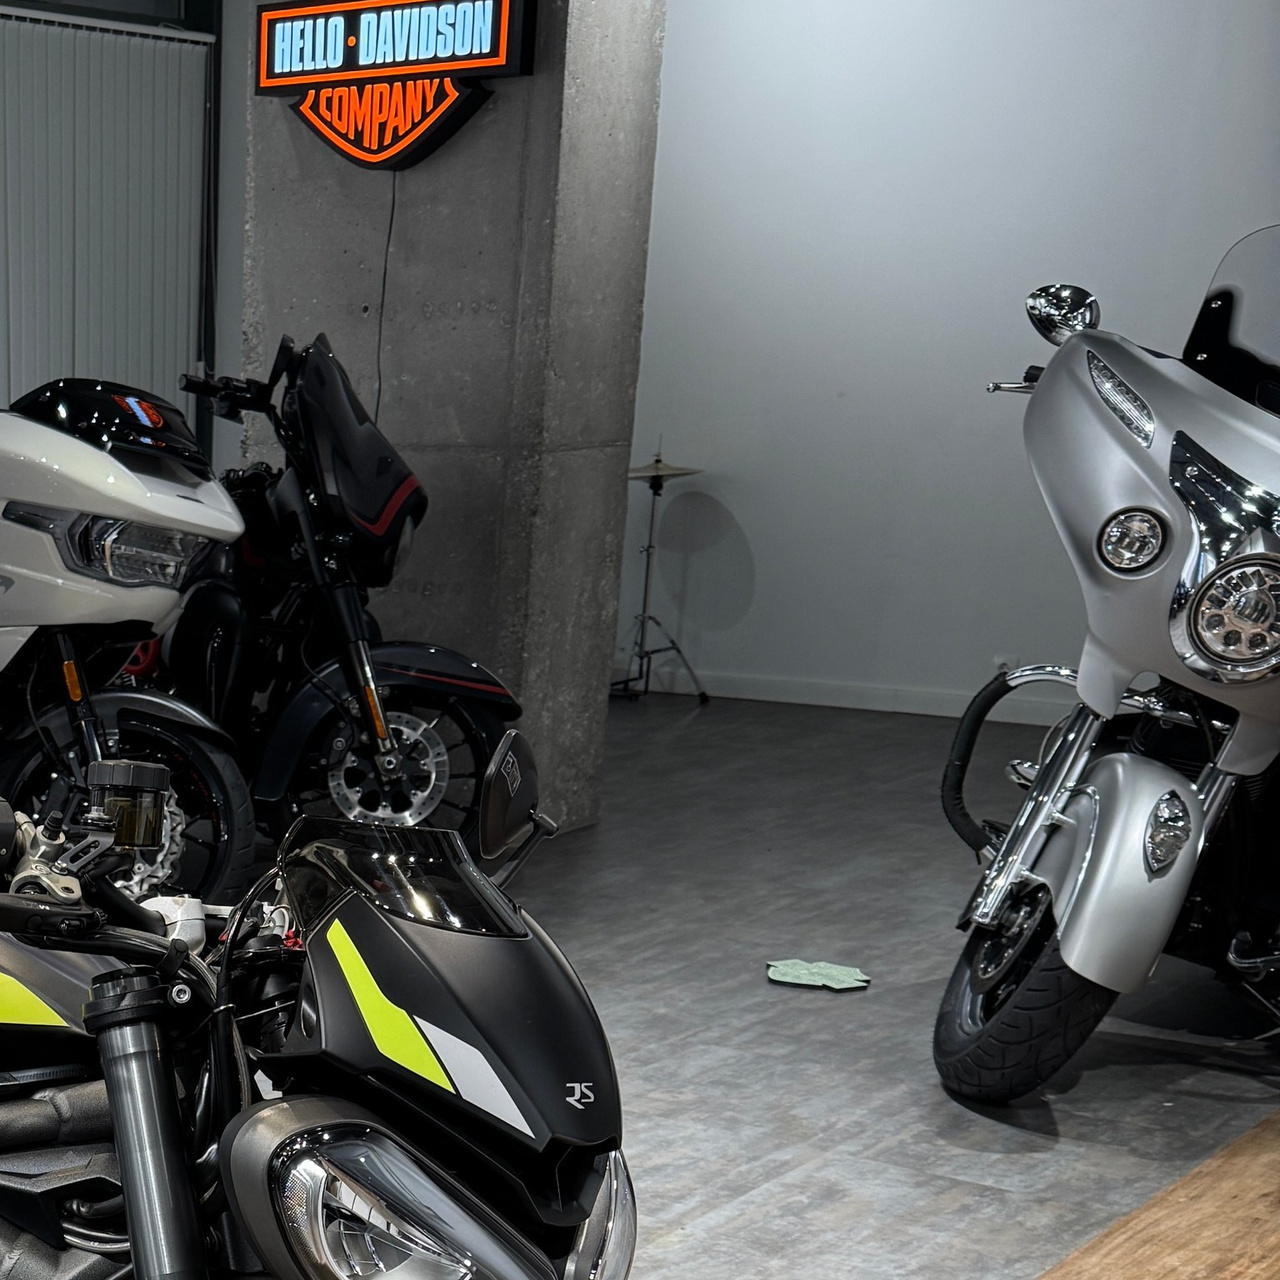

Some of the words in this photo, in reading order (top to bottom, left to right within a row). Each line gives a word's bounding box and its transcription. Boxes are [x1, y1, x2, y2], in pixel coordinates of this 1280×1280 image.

[274, 16, 345, 73] HELLO
[358, 0, 493, 66] DAVIDSON
[318, 78, 440, 150] COMPANY
[565, 1082, 595, 1109] RS
